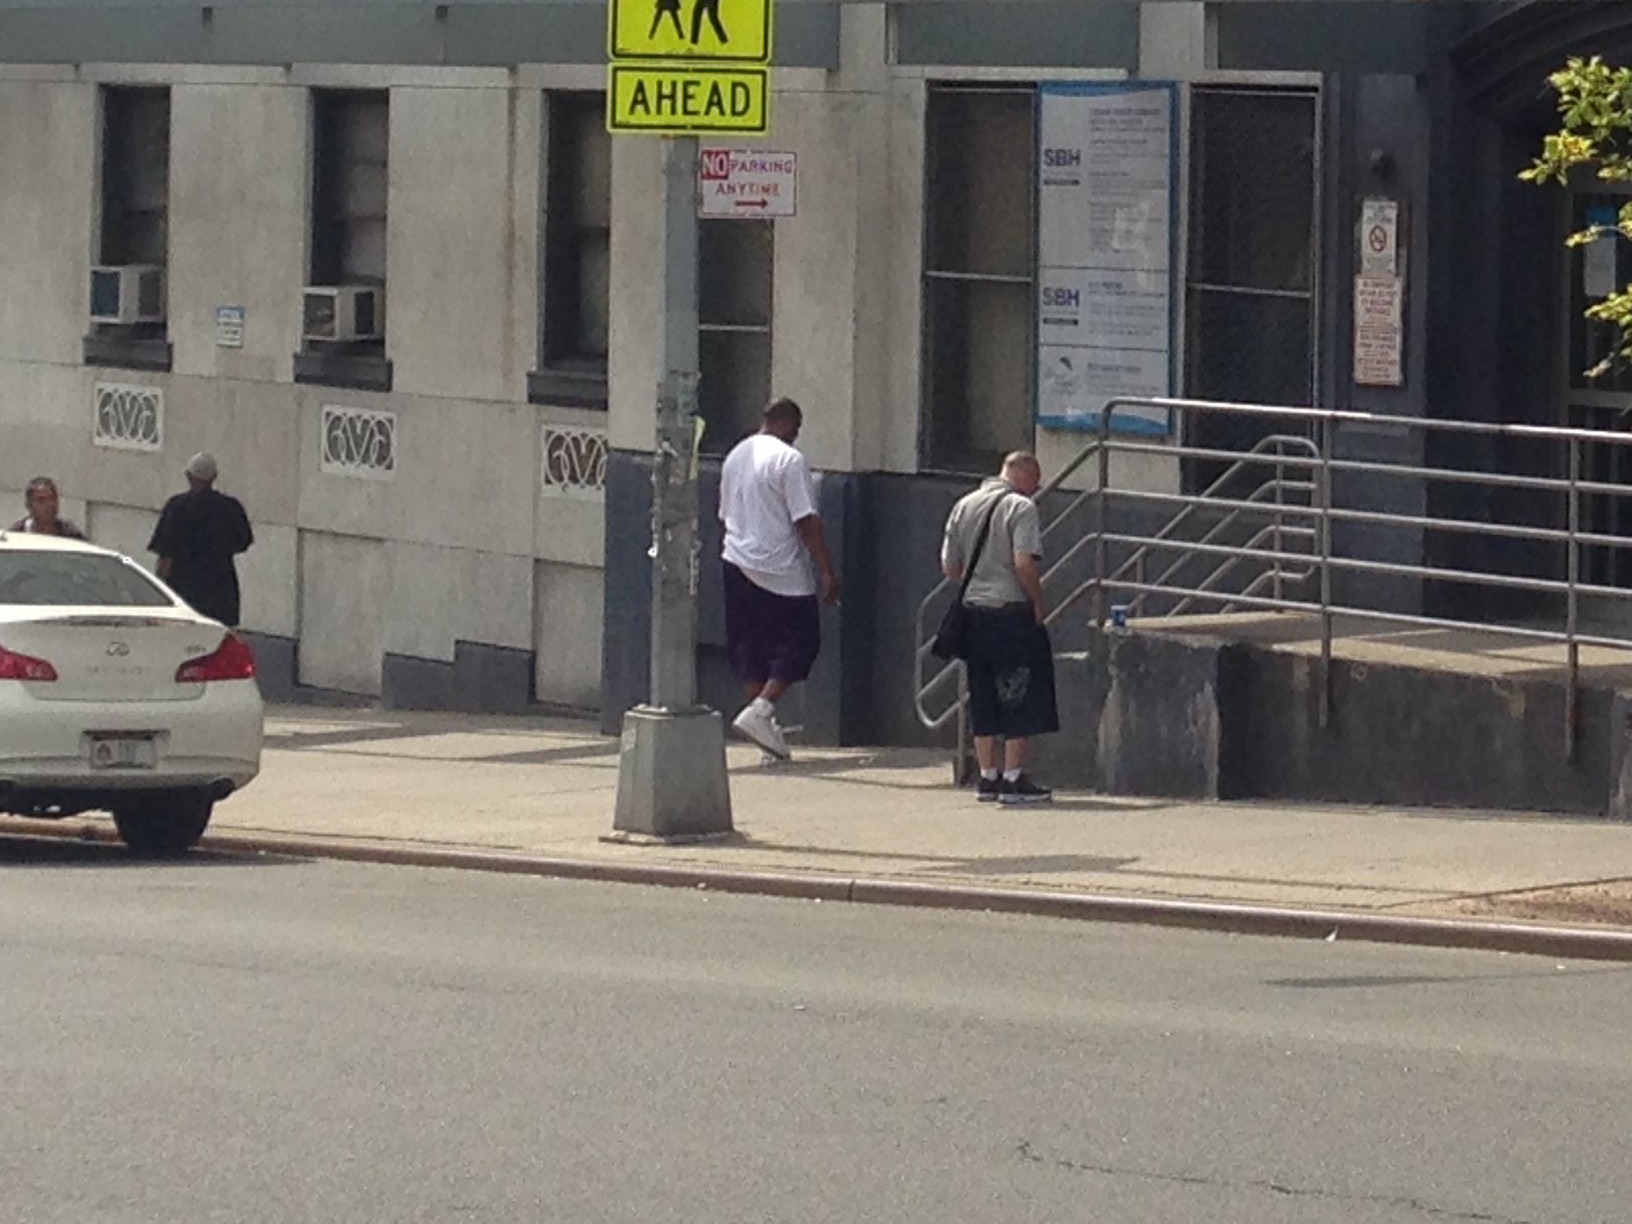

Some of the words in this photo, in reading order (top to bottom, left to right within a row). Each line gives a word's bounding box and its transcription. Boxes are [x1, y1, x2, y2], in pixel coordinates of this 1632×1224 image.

[628, 79, 751, 117] AHEAD
[702, 154, 728, 177] NO
[729, 159, 793, 174] PARKING
[1043, 148, 1081, 167] SBH
[715, 182, 781, 196] ANYTIME
[1042, 286, 1080, 308] SBH
